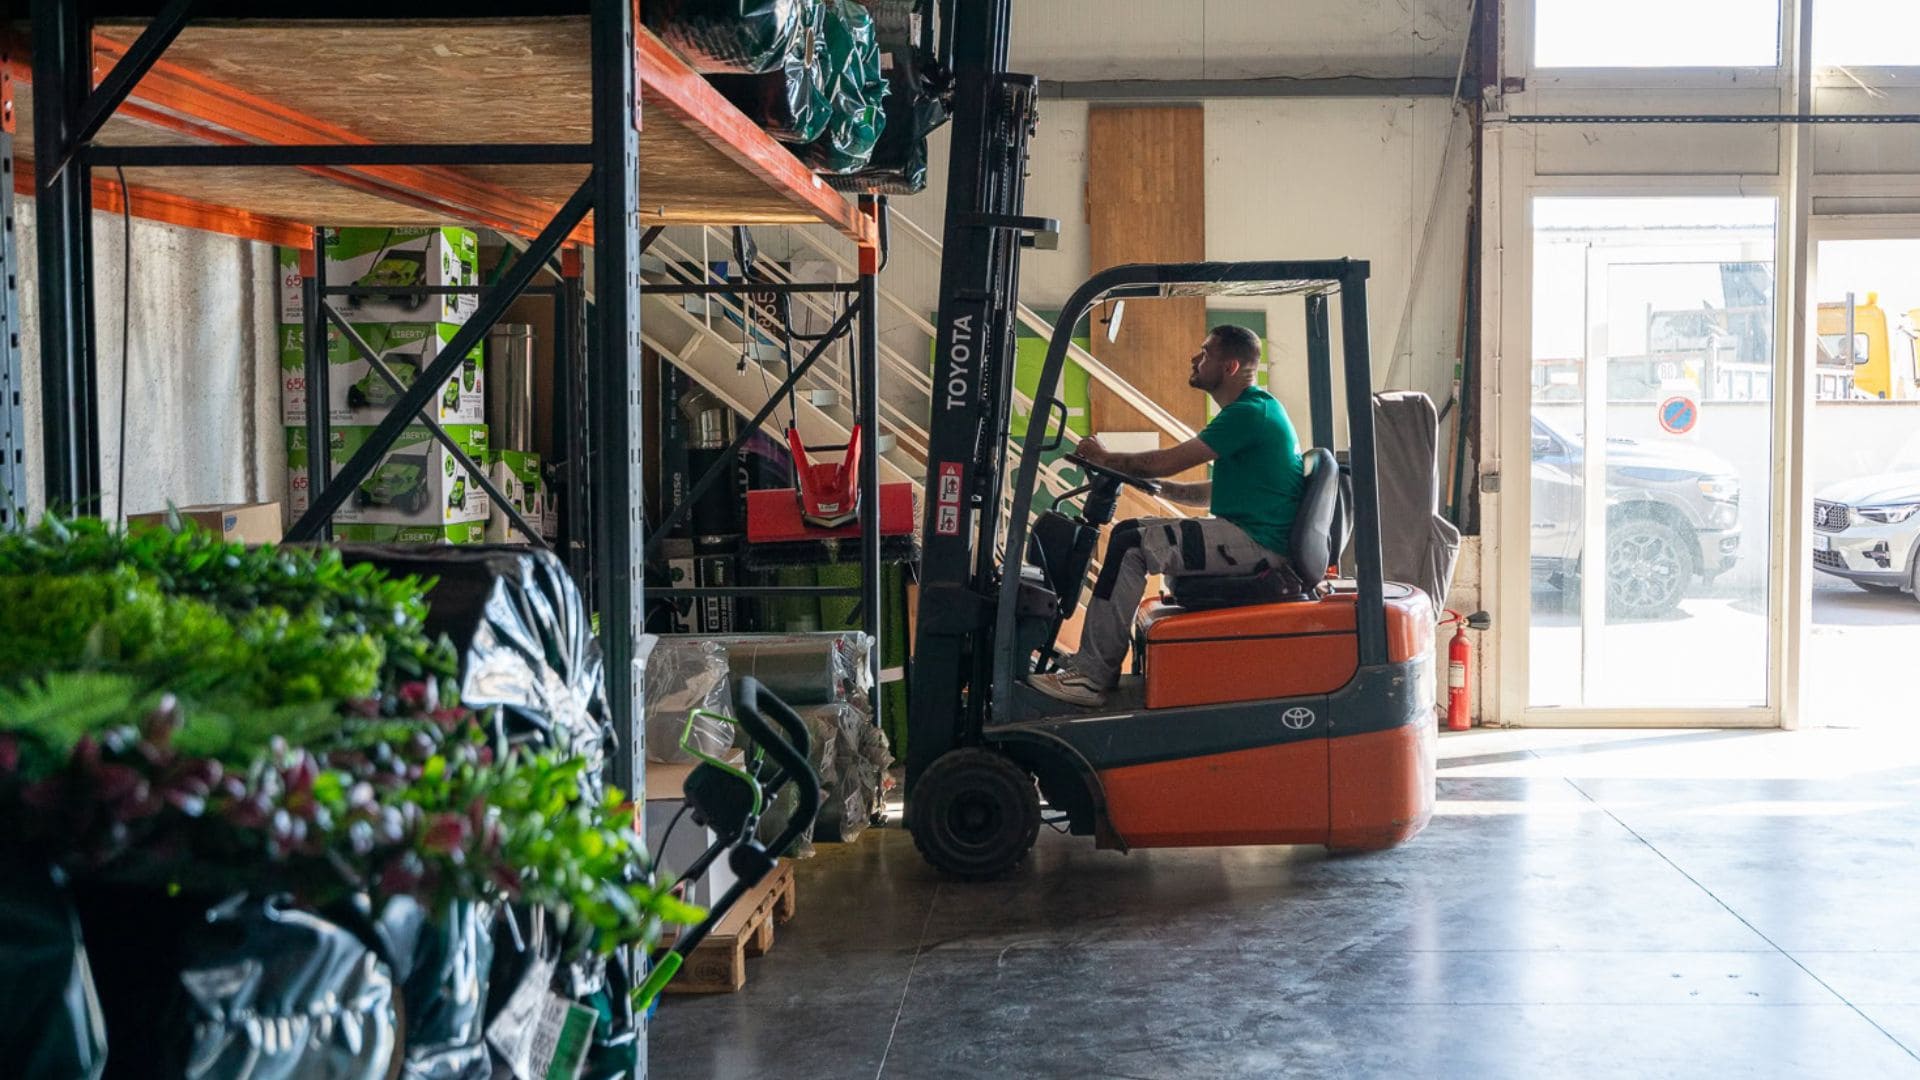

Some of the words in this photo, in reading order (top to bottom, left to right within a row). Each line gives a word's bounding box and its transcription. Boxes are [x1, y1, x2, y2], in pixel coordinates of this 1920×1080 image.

[391, 329, 427, 339] LIBERTY
[947, 314, 973, 411] TOYOTA
[399, 533, 434, 543] LIBERTY
